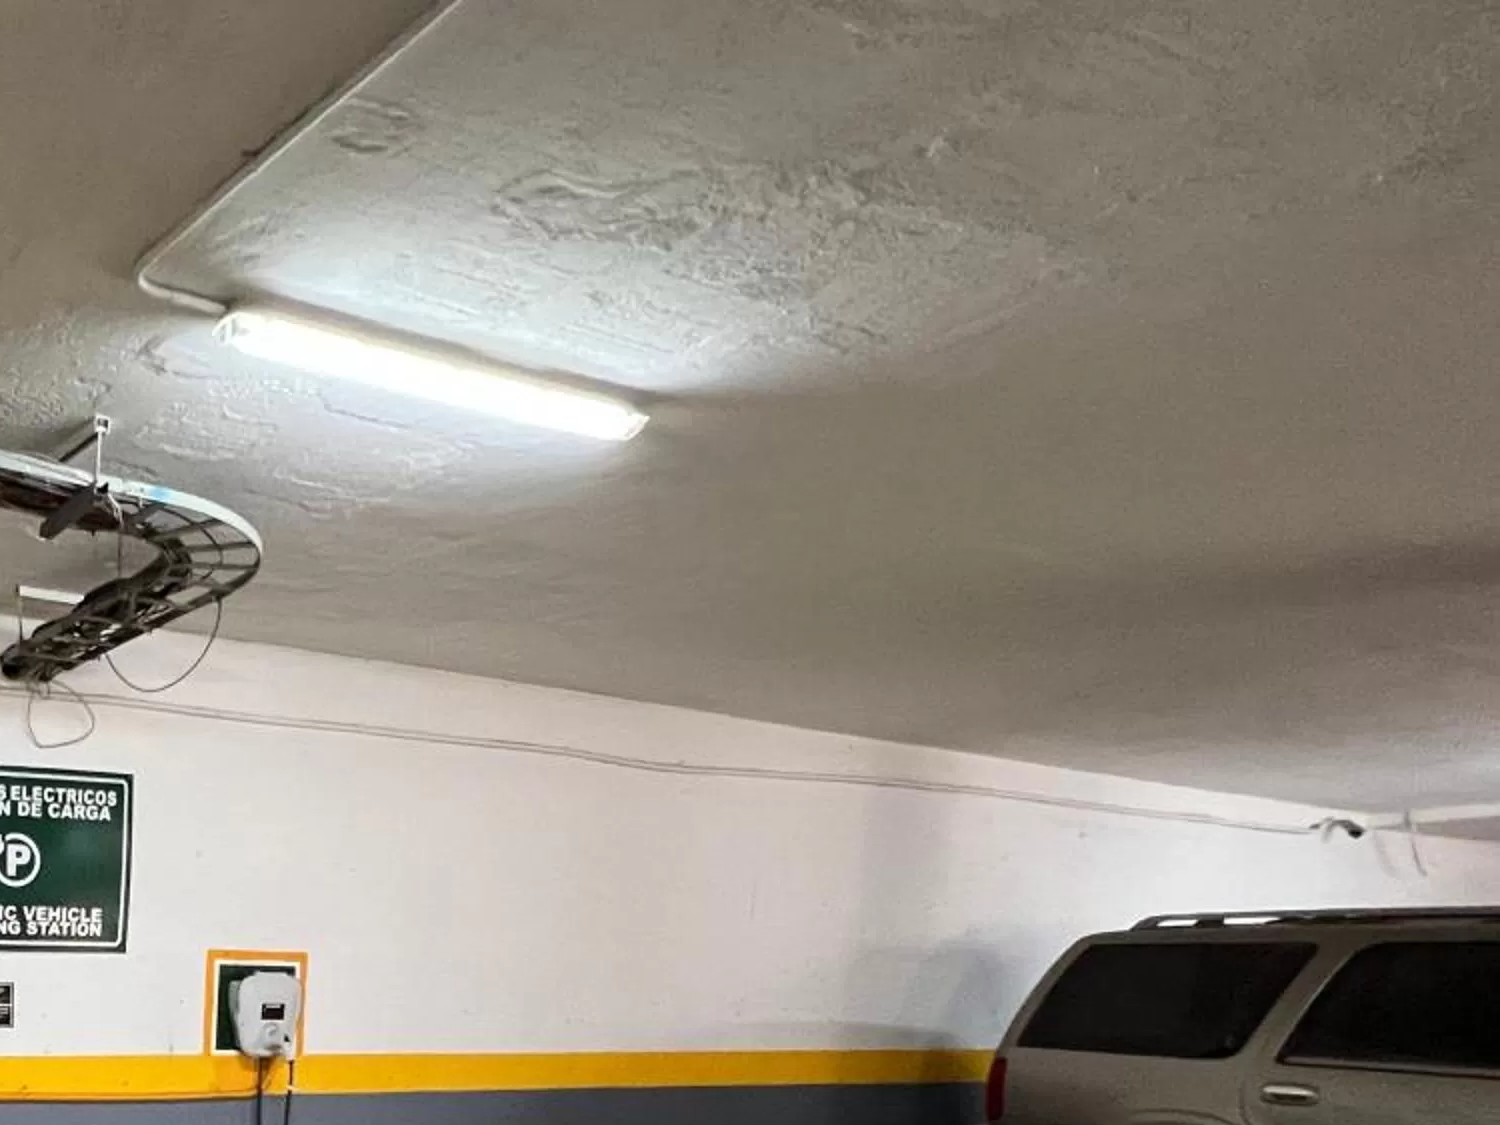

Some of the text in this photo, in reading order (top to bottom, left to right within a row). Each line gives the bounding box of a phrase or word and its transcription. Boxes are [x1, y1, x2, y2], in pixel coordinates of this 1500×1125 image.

[10, 785, 117, 807] ELECTRICOS
[17, 801, 43, 817] DE
[47, 803, 111, 821] CARGA
[6, 843, 31, 876] P
[23, 906, 103, 923] VEHICLE
[26, 921, 102, 937] STATION
